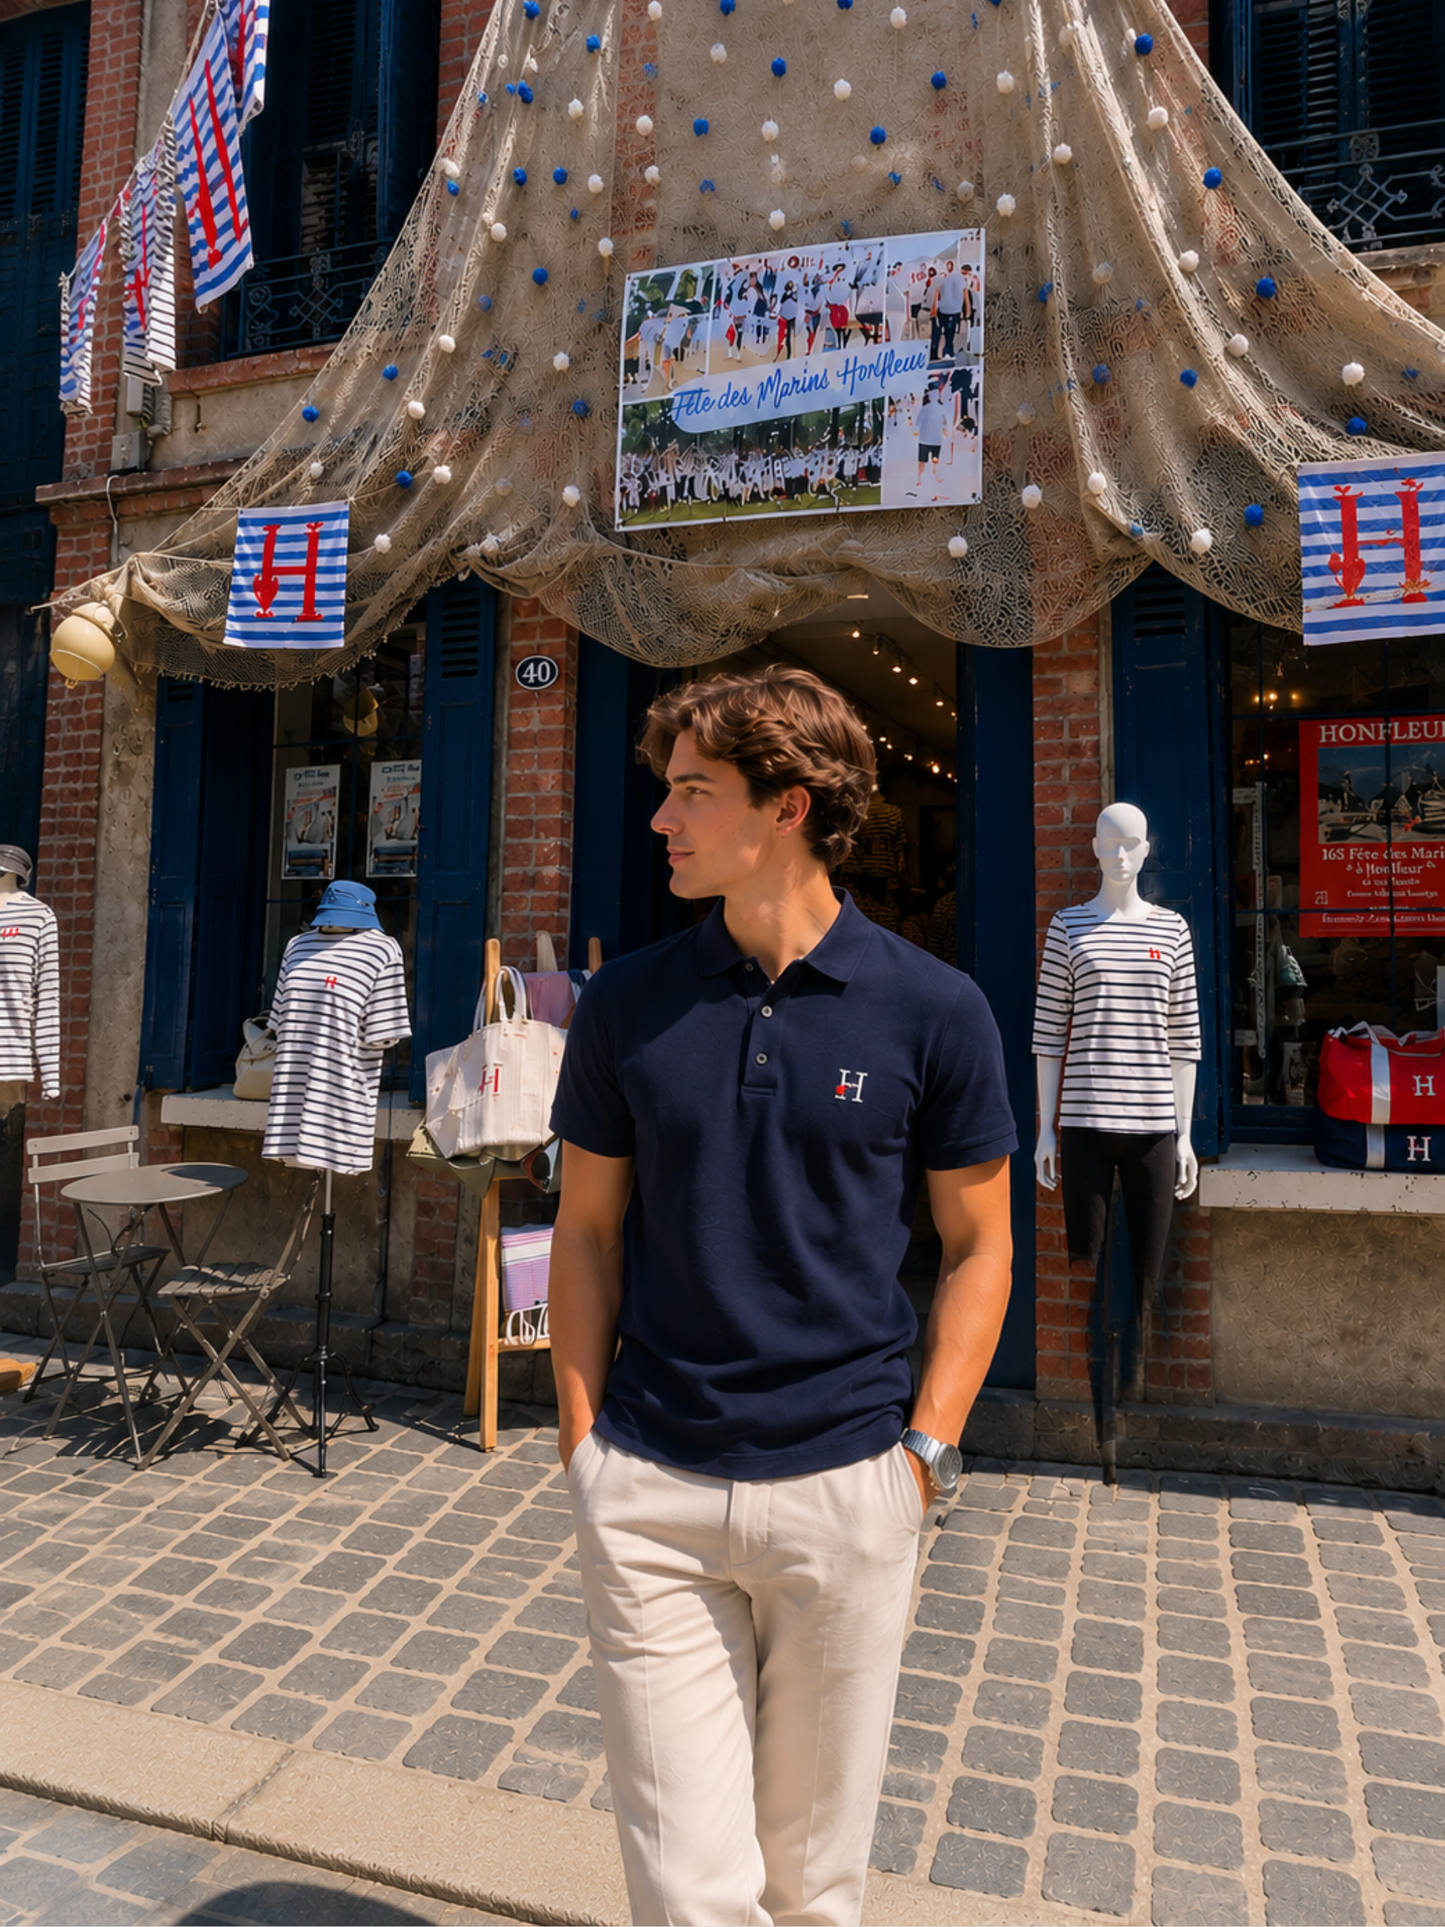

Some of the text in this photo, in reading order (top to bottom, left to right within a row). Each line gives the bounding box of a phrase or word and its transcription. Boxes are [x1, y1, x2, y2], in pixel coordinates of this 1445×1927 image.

[718, 382, 752, 410] des
[252, 521, 324, 622] H
[522, 661, 550, 684] 40
[324, 976, 338, 989] H
[834, 1068, 868, 1103] H
[1412, 1075, 1436, 1096] H
[1407, 1135, 1432, 1162] H
